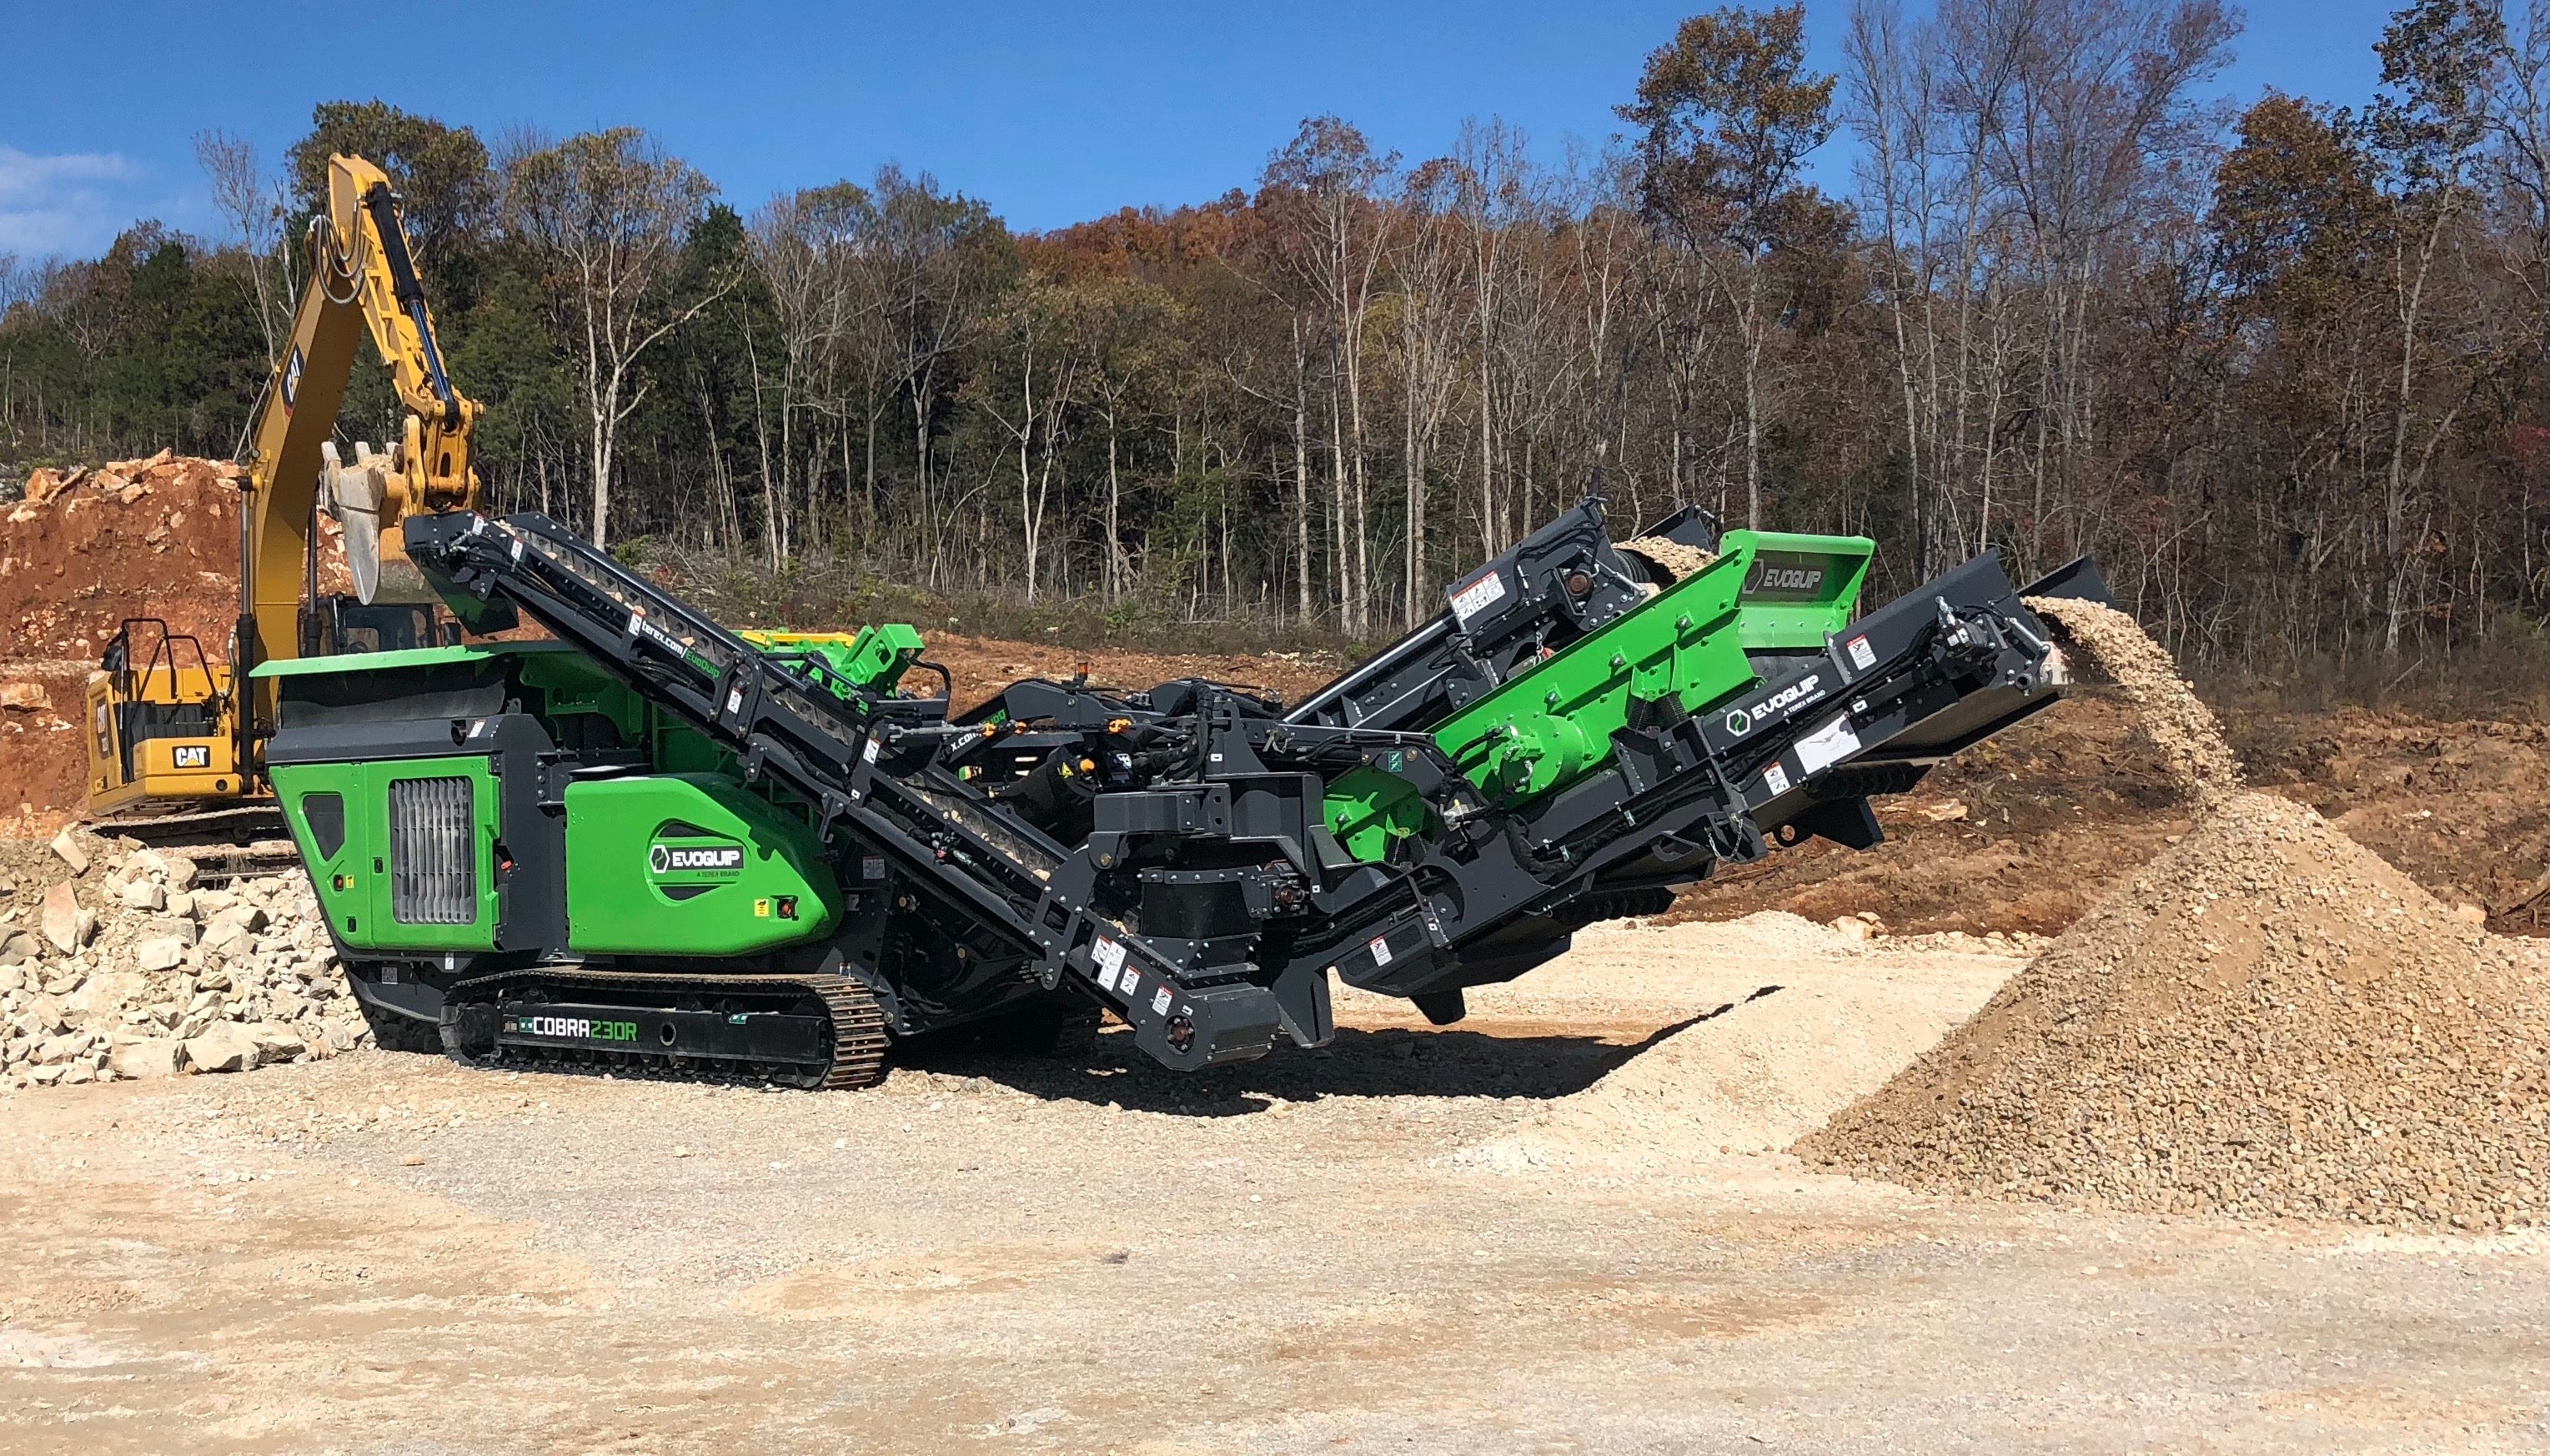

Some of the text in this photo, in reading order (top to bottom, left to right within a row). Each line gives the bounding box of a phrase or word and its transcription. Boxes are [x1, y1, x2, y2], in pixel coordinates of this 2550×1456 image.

[1763, 569, 1822, 589] EVOQUIP
[1750, 674, 1820, 720] EVOQUIP
[175, 746, 207, 767] CAT
[672, 850, 740, 867] EVOQUIP
